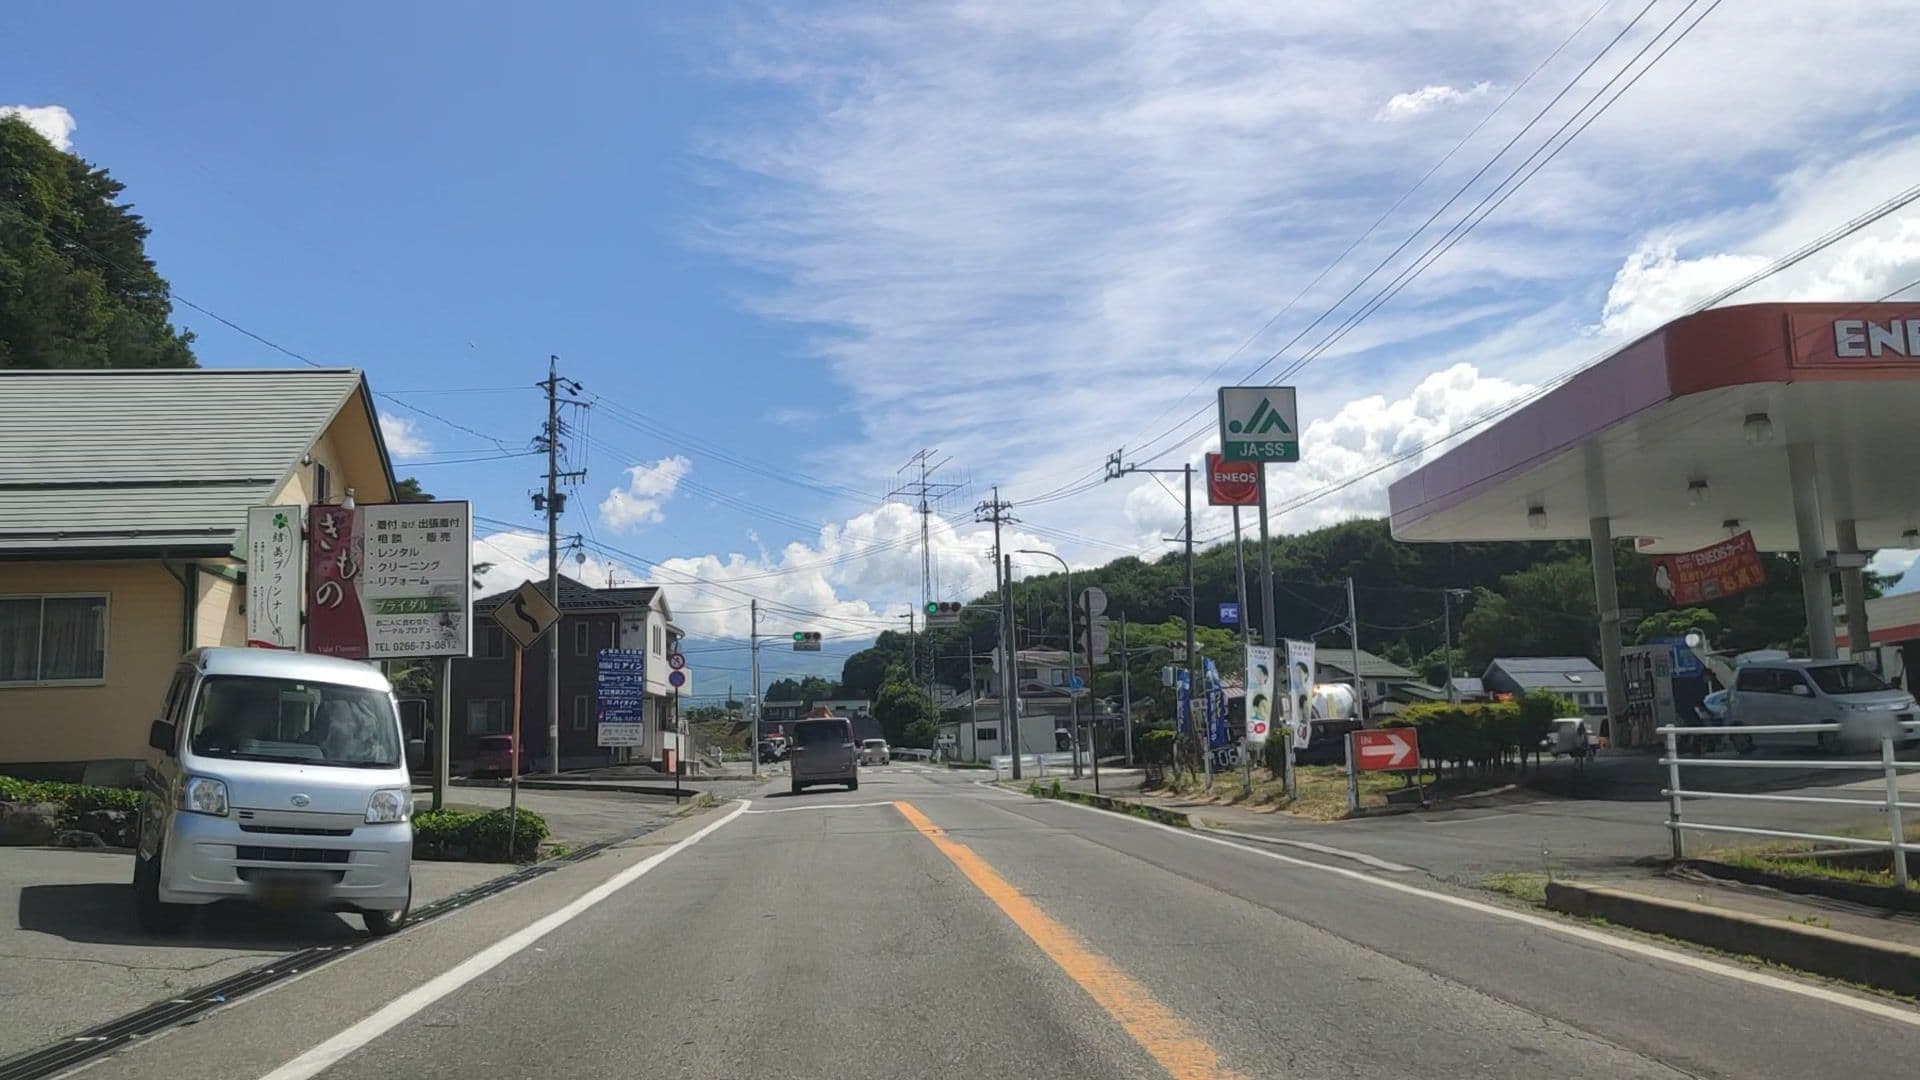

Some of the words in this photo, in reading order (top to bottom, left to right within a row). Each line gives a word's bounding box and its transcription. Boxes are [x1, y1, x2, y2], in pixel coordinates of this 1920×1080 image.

[1240, 442, 1285, 457] JA-SS
[1214, 472, 1256, 483] ENEOS
[316, 512, 357, 609] きもの
[374, 642, 391, 652] TEL
[1360, 735, 1373, 745] IN
